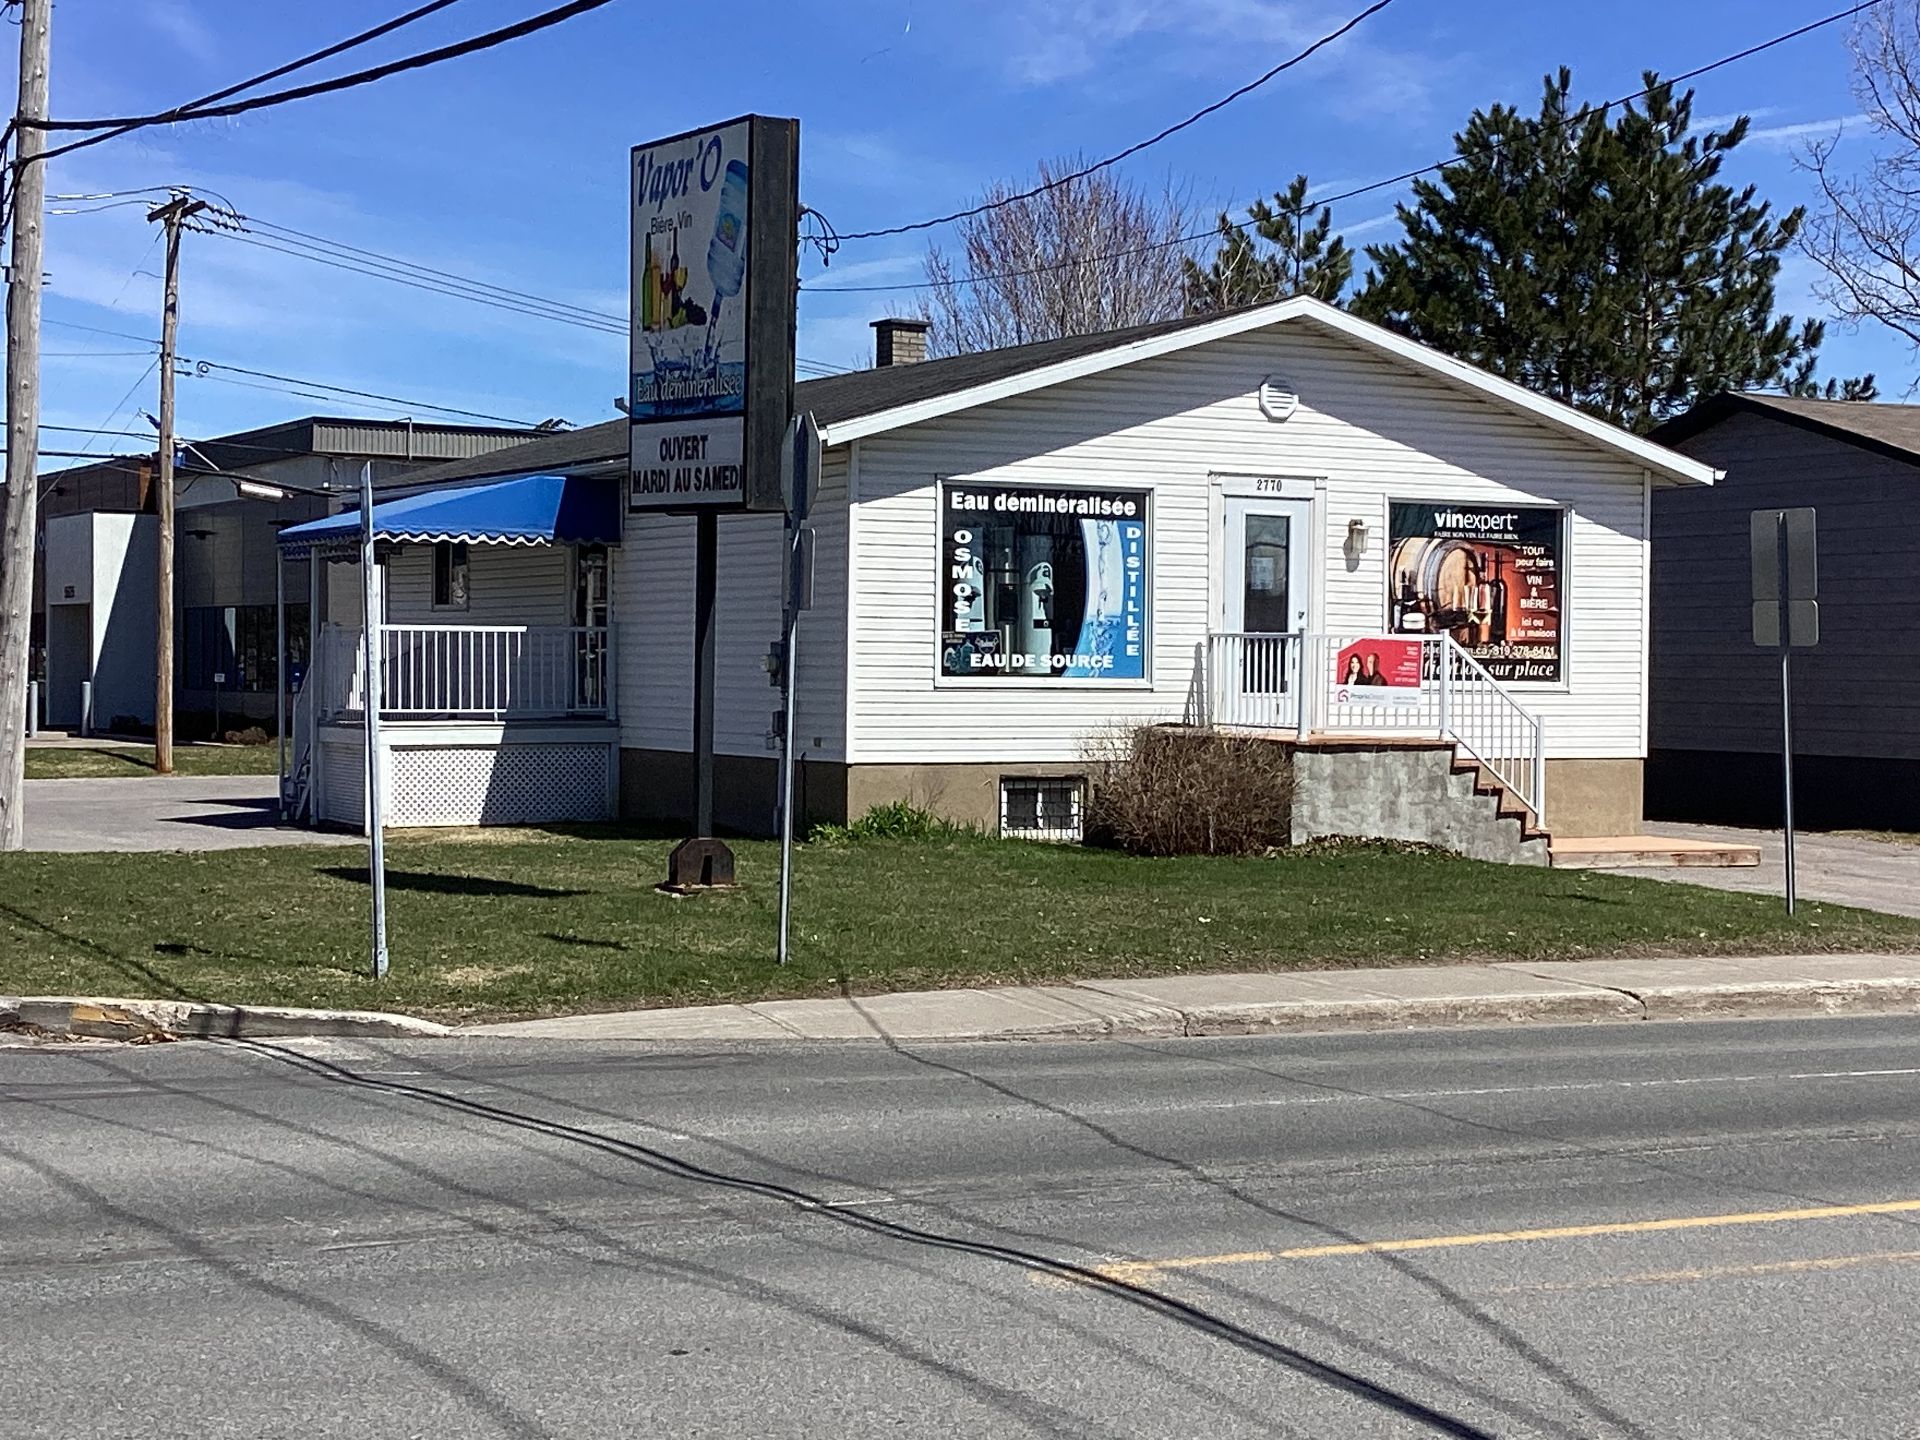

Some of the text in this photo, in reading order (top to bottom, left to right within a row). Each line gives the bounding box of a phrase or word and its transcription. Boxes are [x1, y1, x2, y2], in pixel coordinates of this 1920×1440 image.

[638, 135, 722, 213] Vapor'O
[677, 211, 692, 229] Vin
[637, 376, 659, 402] Eau
[659, 434, 709, 462] OUVERT
[632, 464, 743, 494] MARDI AU SAMEDI
[1257, 479, 1282, 492] 2770
[951, 491, 1137, 516] Eau déminéralisée
[1434, 508, 1514, 532] vinexpert
[1522, 546, 1545, 556] TOUT
[1515, 556, 1554, 568] pour faire
[952, 529, 973, 632] OSMOSE
[1526, 575, 1543, 586] VIN
[1530, 586, 1538, 597] &
[970, 653, 1114, 669] EAU DE SOURCE
[1488, 663, 1512, 676] sur
[1514, 661, 1555, 679] place
